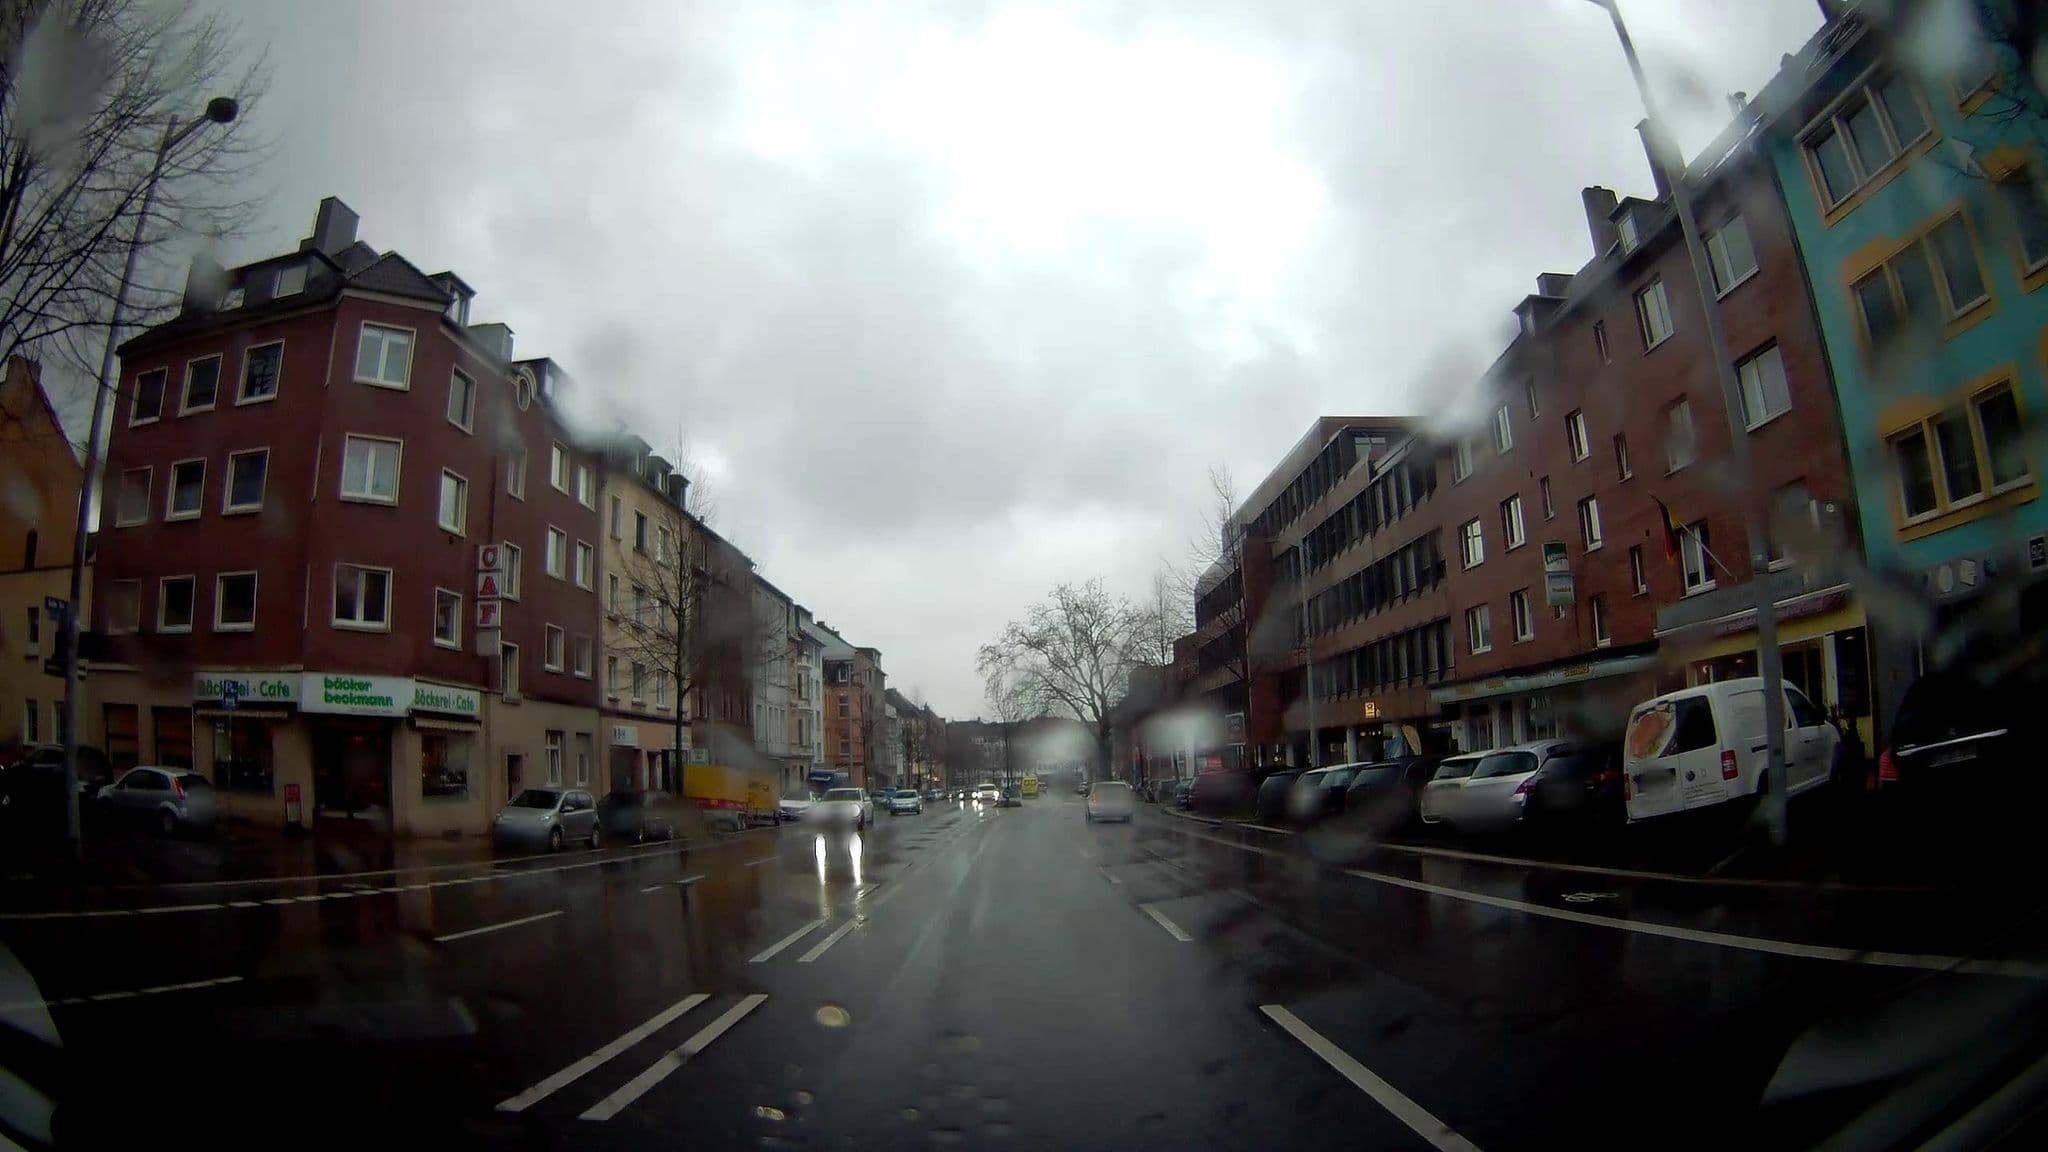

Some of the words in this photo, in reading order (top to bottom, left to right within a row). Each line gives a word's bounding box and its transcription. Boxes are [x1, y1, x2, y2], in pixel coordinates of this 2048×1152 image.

[199, 680, 249, 697] Bäcei
[324, 691, 393, 706] beckmann
[415, 688, 451, 709] Bäckerei
